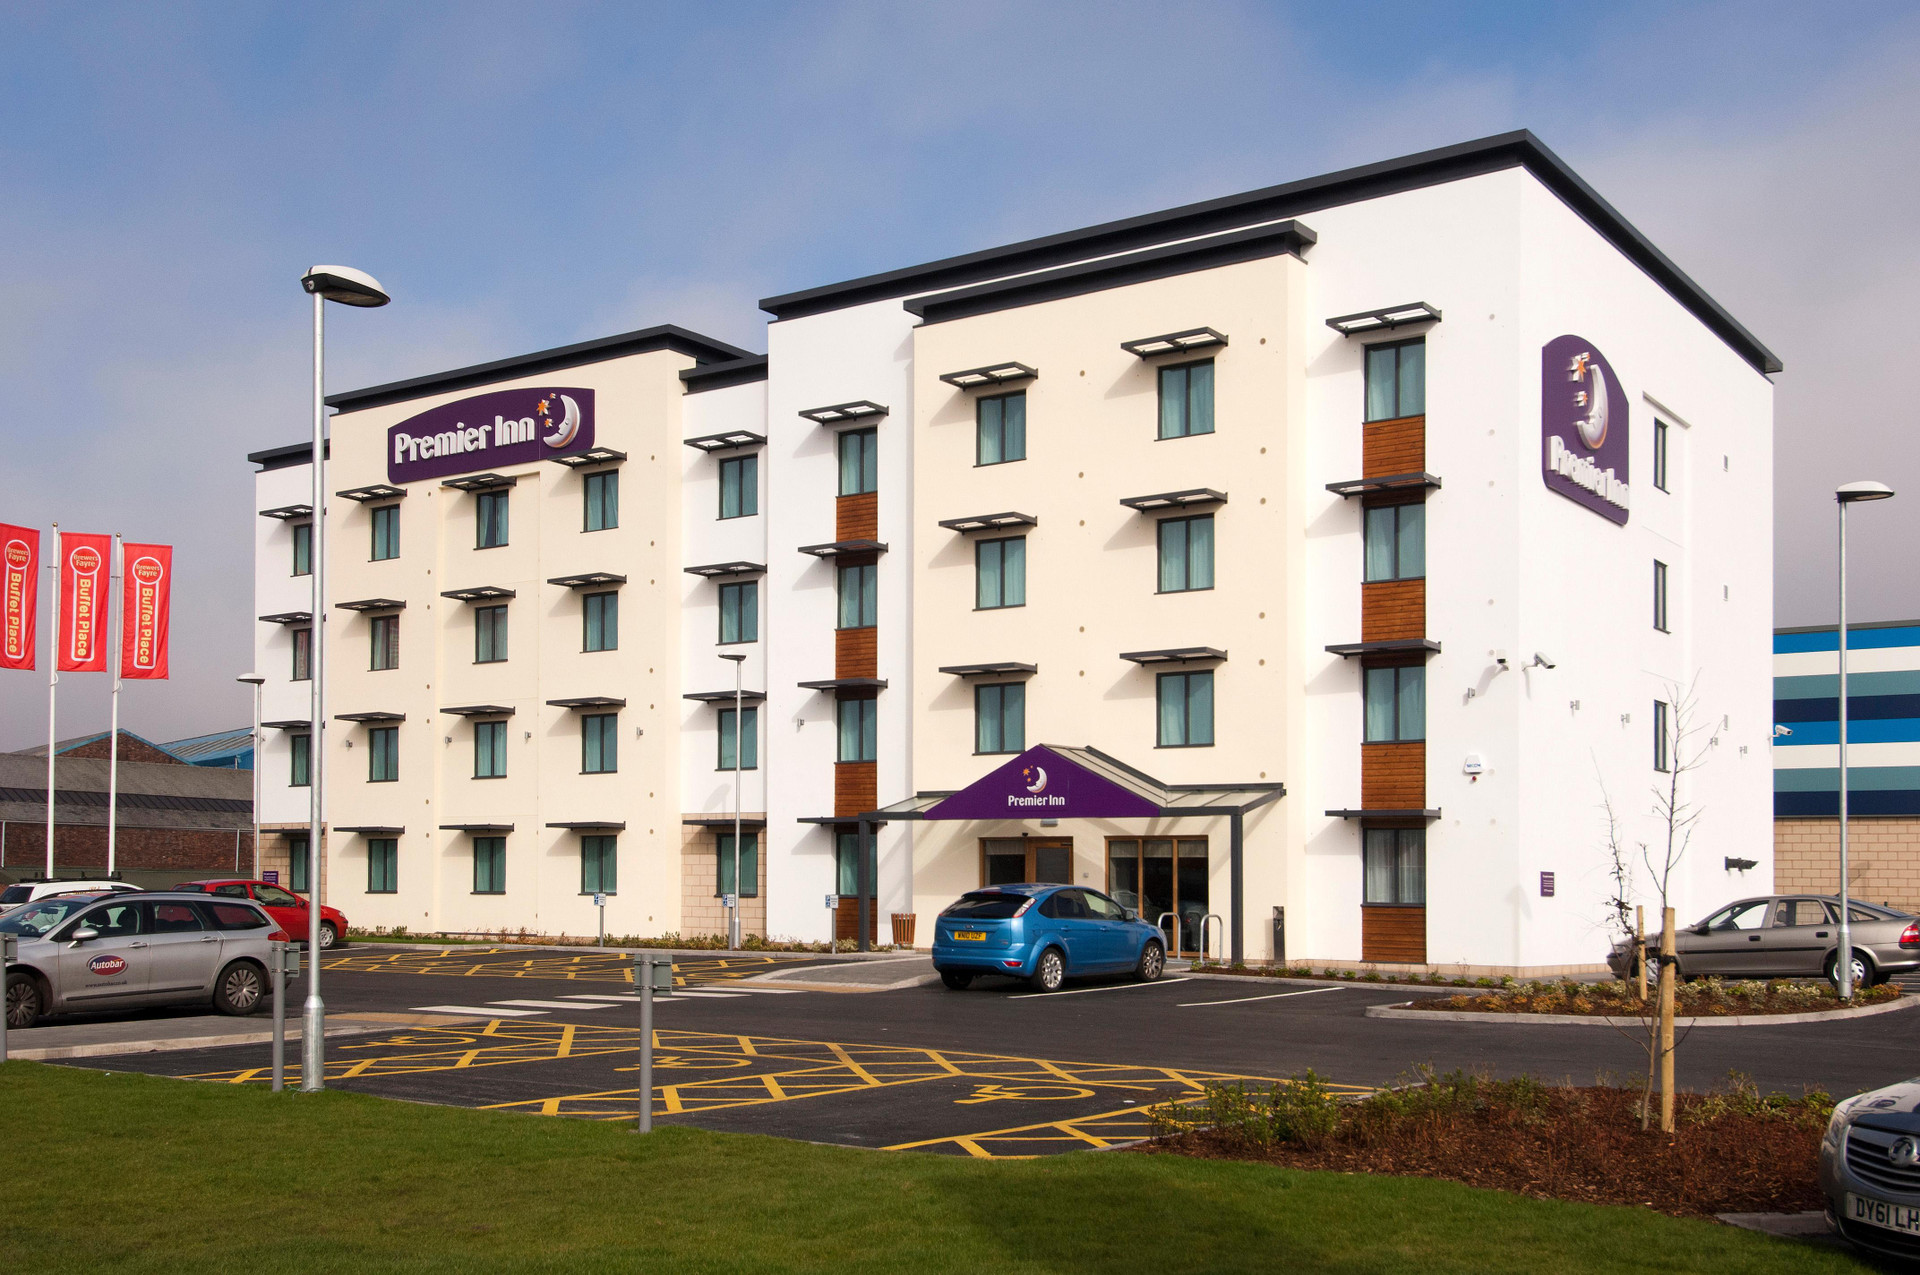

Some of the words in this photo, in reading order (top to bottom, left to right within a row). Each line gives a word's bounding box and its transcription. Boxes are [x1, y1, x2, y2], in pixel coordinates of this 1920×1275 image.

[395, 421, 492, 464] Premier
[494, 415, 536, 447] Inn
[7, 547, 28, 556] Brewers
[8, 553, 27, 562] Fayre
[76, 559, 96, 568] Fayre
[138, 569, 158, 577] Fayre
[9, 572, 22, 615] Buffet
[79, 578, 91, 618] Buffet
[141, 587, 154, 626] Buffet
[8, 616, 20, 653] Place
[77, 620, 90, 656] Place
[139, 630, 152, 663] Place
[1008, 795, 1048, 807] Premier
[1049, 794, 1066, 806] Inn
[91, 961, 124, 969] Autobar
[1857, 1198, 1890, 1224] DY61
